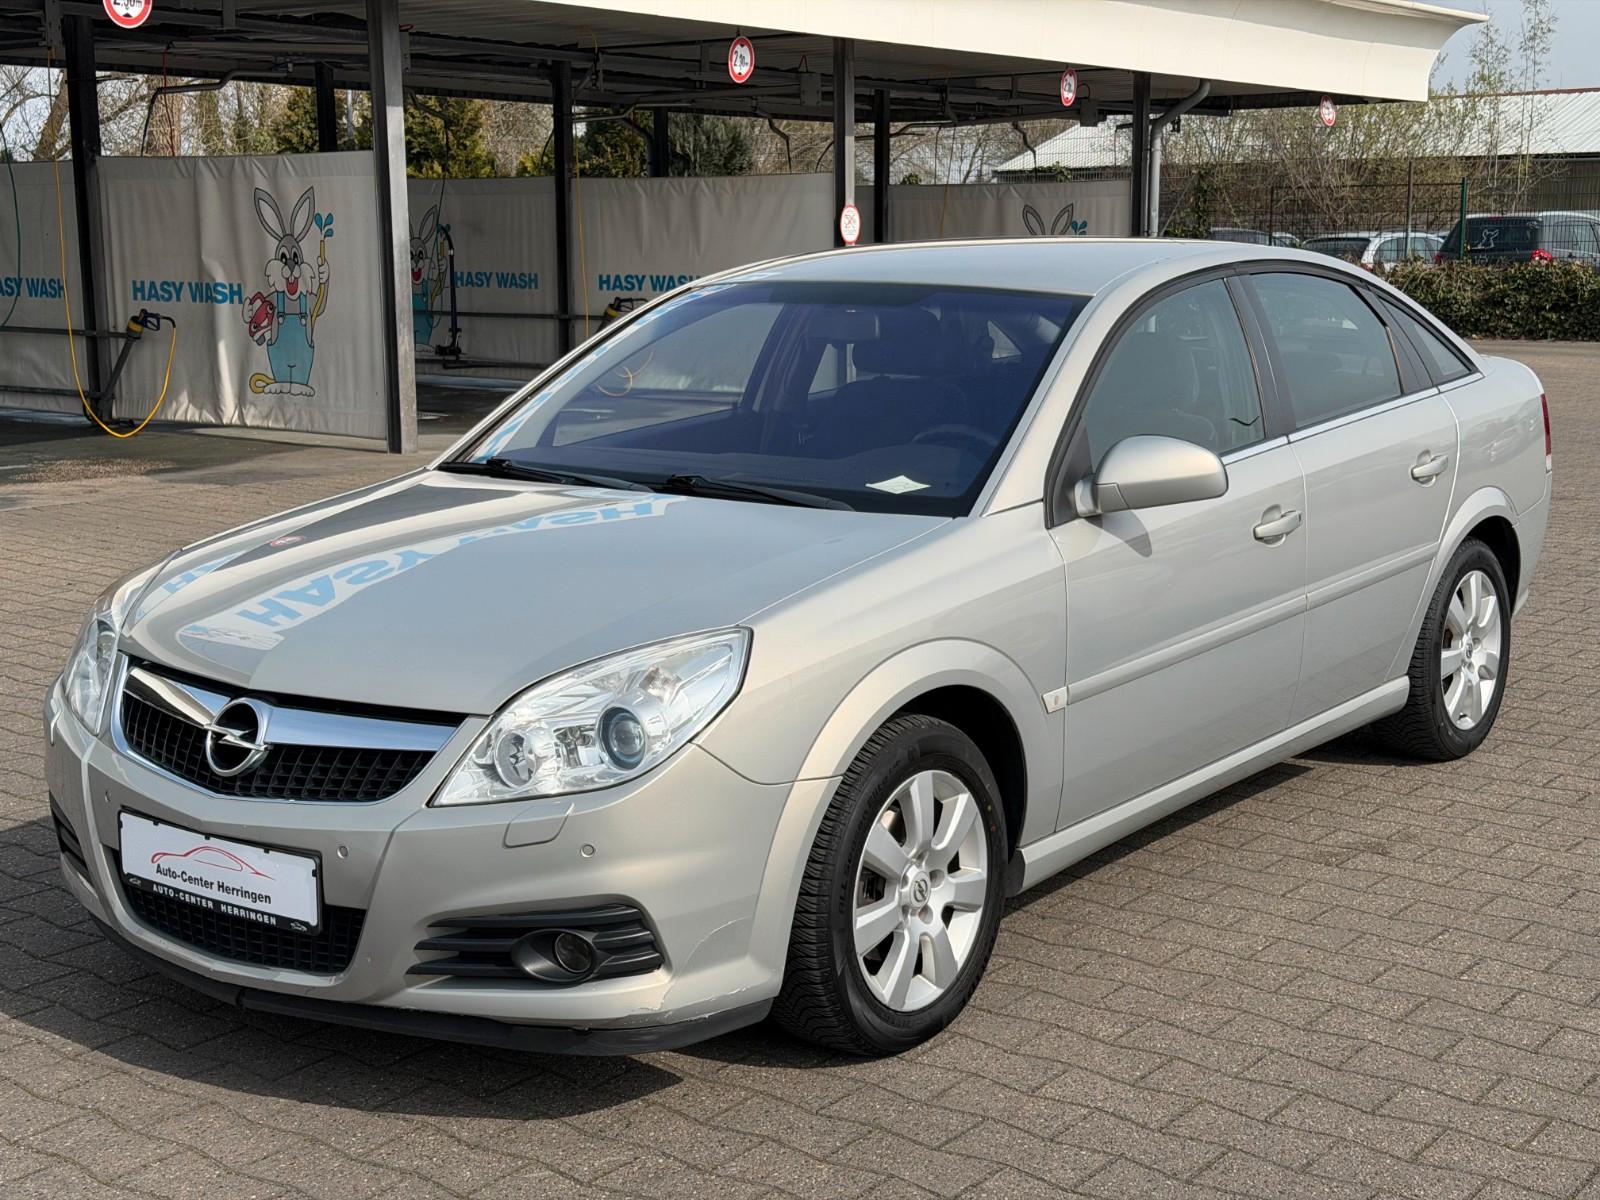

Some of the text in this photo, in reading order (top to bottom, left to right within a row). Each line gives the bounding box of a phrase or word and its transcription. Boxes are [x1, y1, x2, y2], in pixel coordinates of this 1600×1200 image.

[131, 280, 243, 304] HASY WASH
[453, 271, 539, 290] HASY WASH
[598, 274, 702, 292] HASY WAS
[155, 863, 272, 905] Auto-Center Herringen
[152, 884, 277, 926] AUTO-CENTER HERRINGEN
